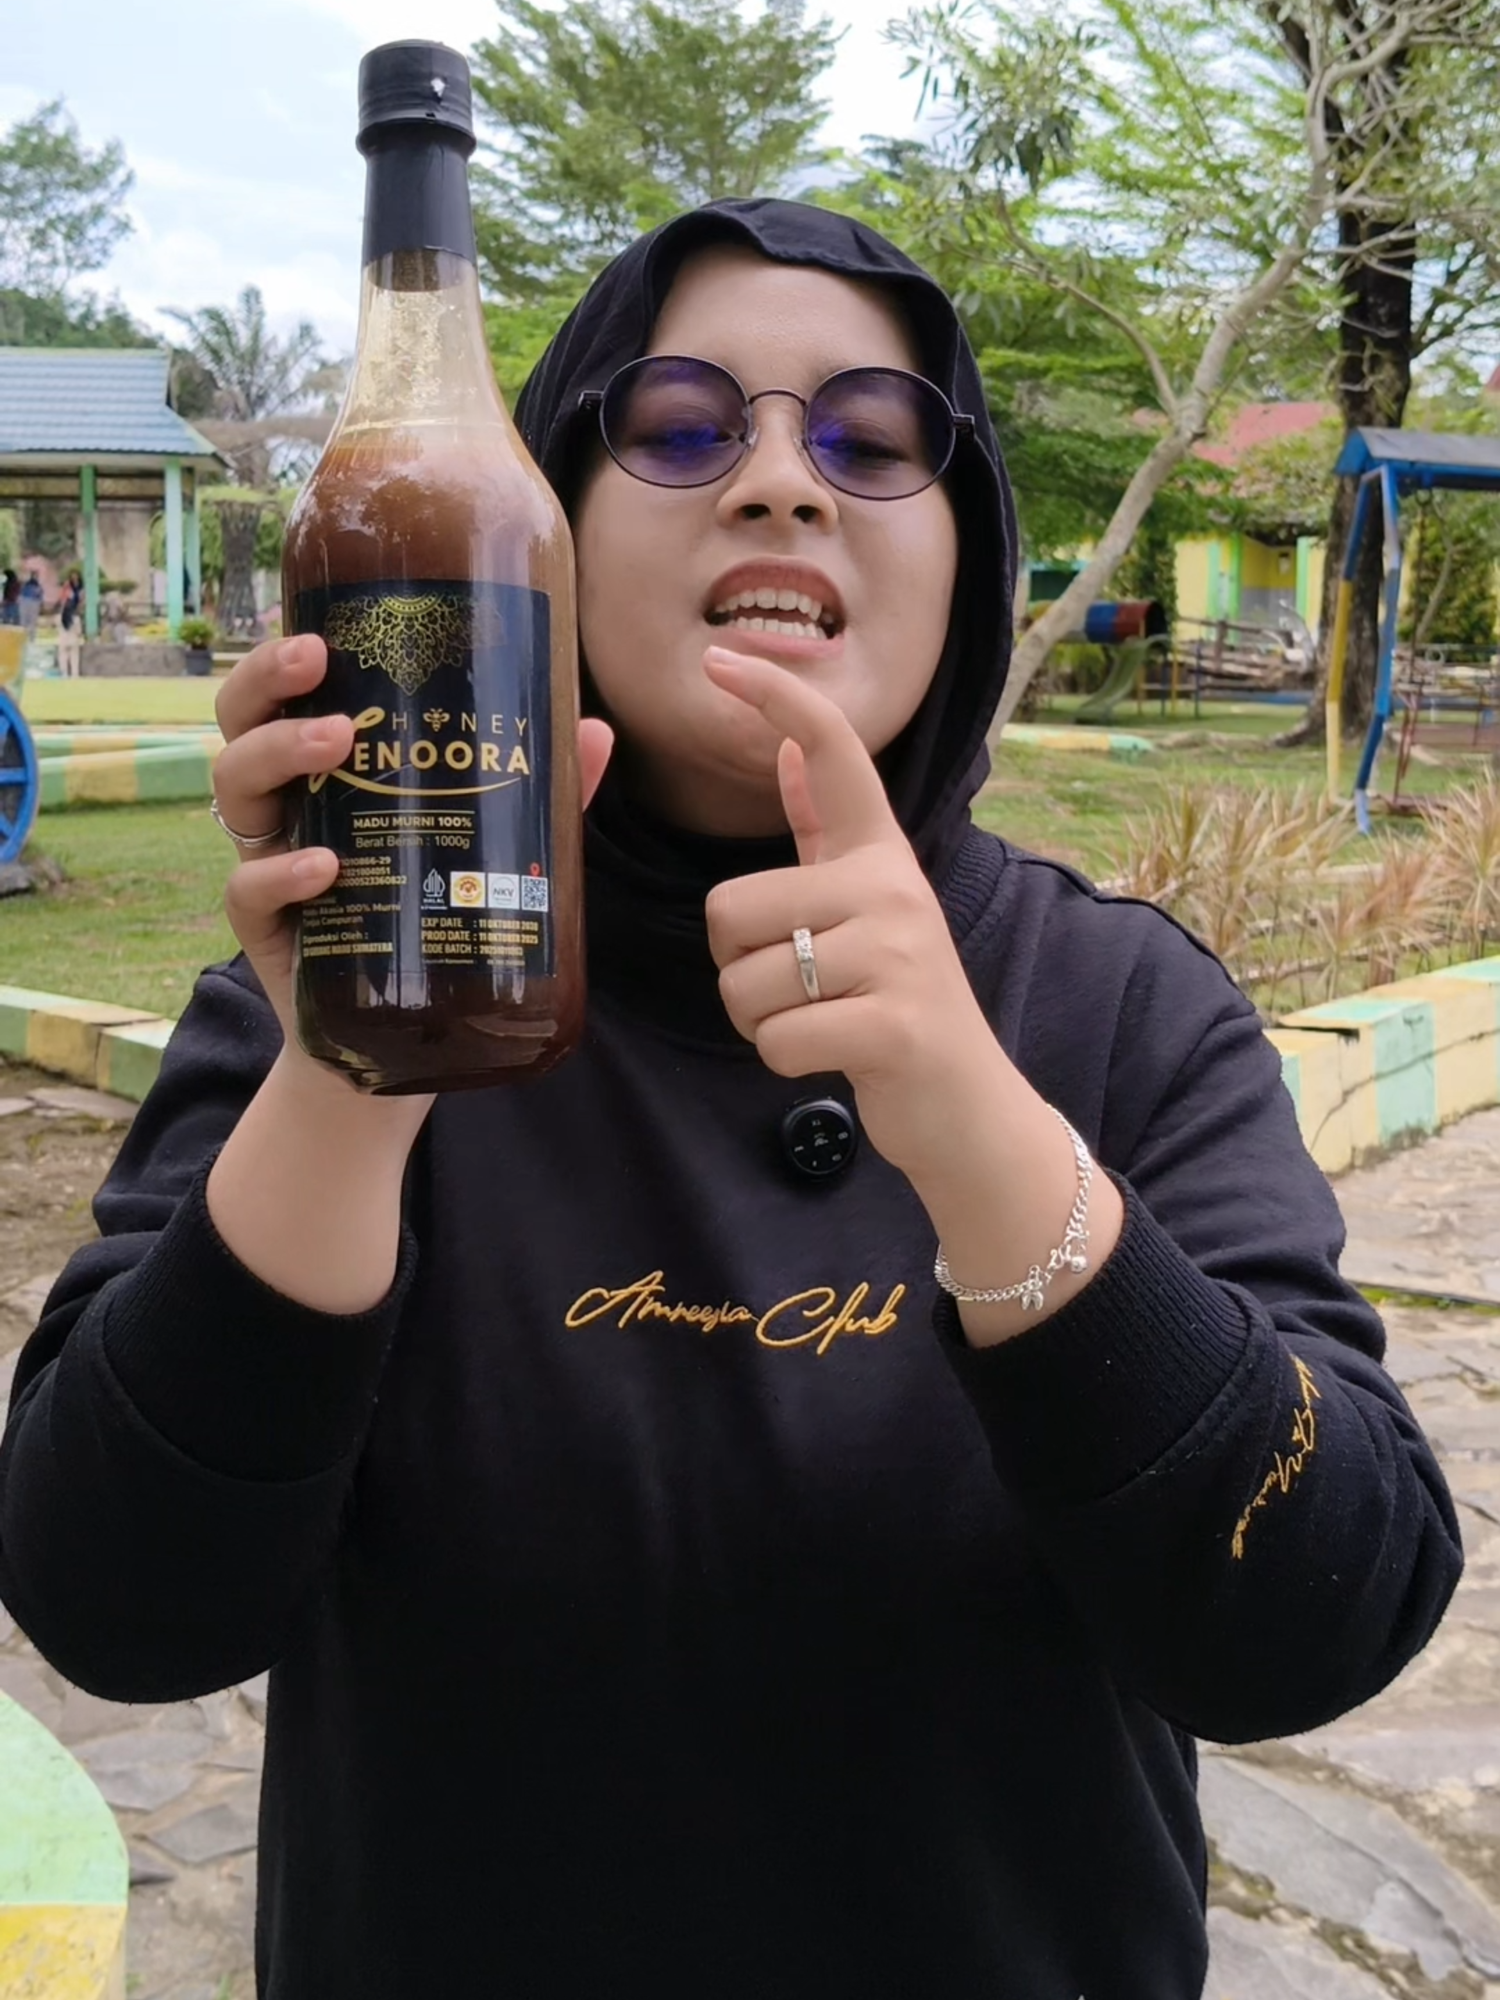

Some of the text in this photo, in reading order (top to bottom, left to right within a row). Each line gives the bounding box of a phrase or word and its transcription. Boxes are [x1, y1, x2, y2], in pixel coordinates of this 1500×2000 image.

[344, 735, 531, 777] ENOORA
[353, 816, 472, 829] MADU MURNI 100%
[355, 836, 384, 848] Berat
[386, 835, 423, 847] Bersih
[434, 835, 470, 850] 1000g
[421, 917, 439, 927] EXP
[440, 917, 463, 927] DATE
[421, 930, 446, 941] PROD
[447, 930, 471, 941] DATE
[421, 943, 443, 954] KODE
[444, 944, 472, 954] BATCH
[755, 1281, 906, 1354] Club
